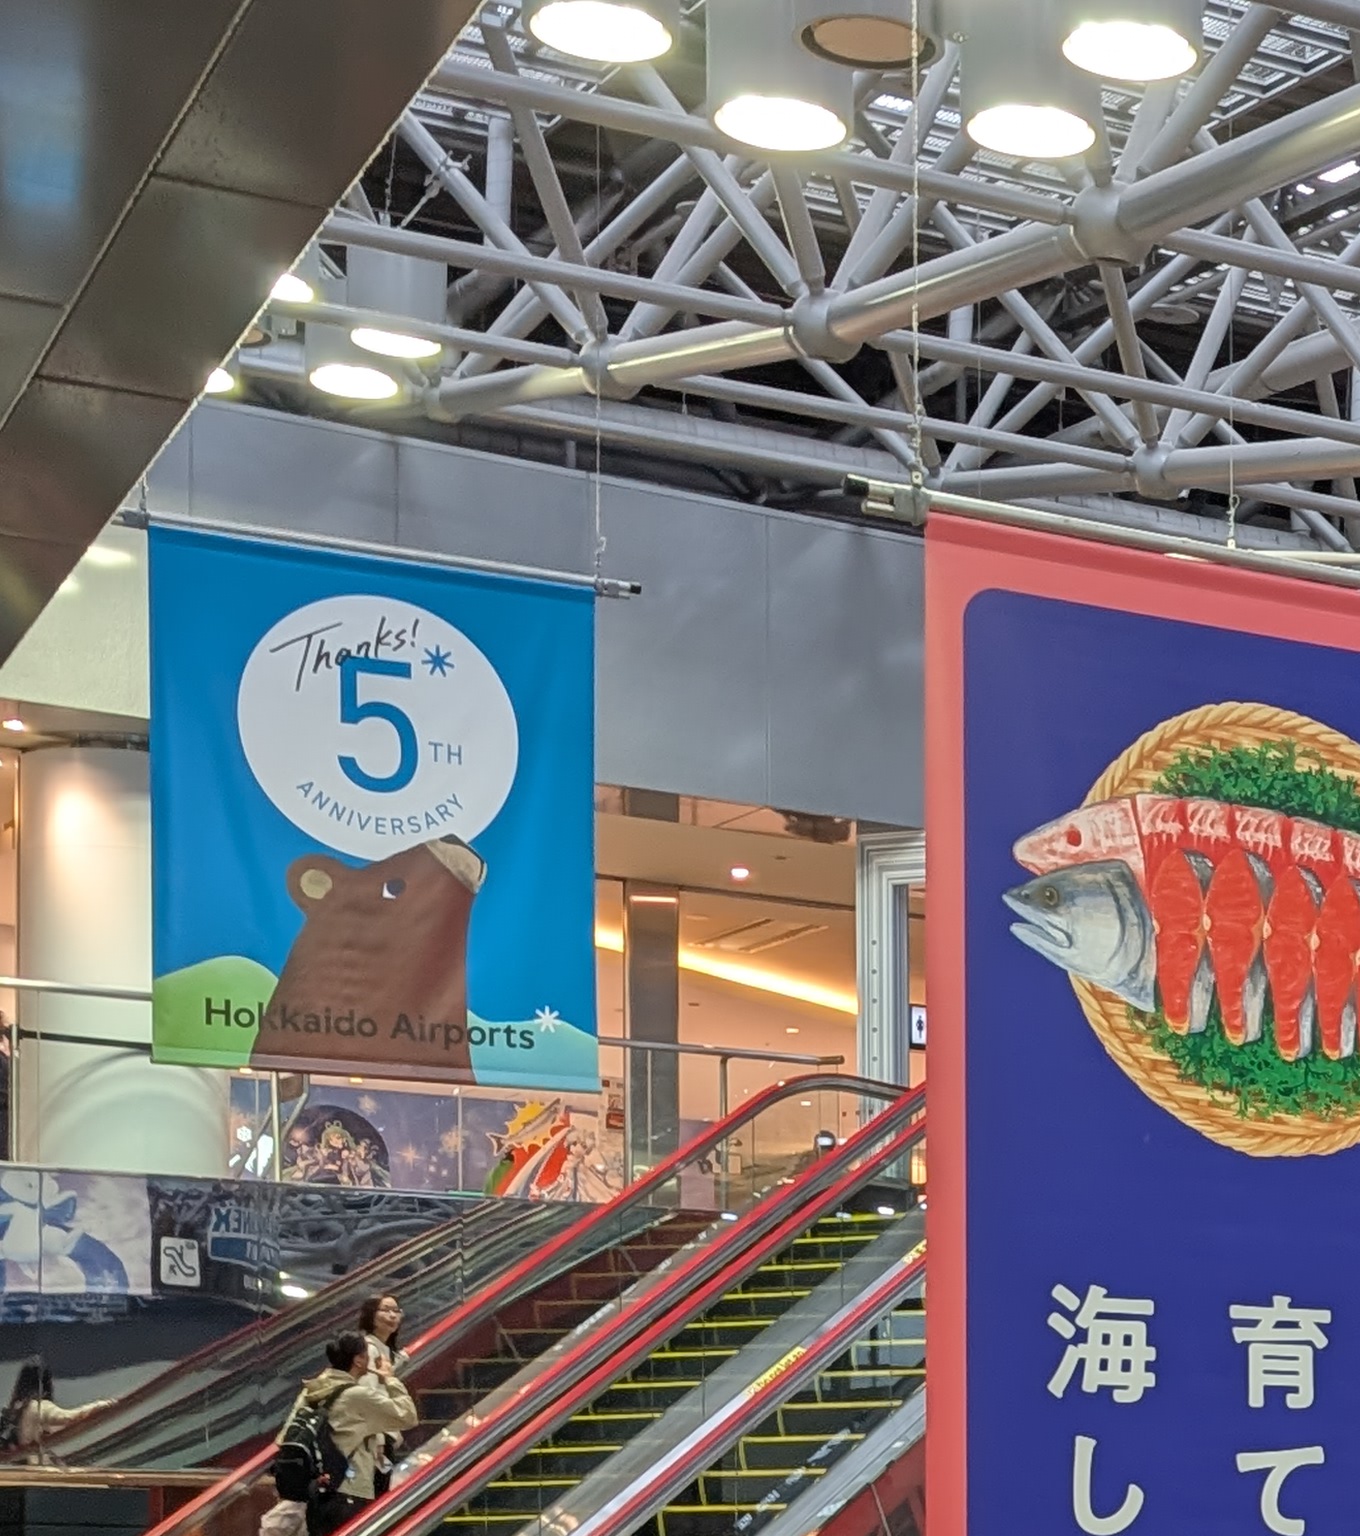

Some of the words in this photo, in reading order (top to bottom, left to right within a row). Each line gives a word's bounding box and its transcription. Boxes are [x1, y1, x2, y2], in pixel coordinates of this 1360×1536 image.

[271, 619, 420, 691] Thanks!
[294, 778, 466, 838] ANNIVERSARY
[203, 996, 380, 1041] Hokkaido
[390, 1013, 536, 1053] Airports
